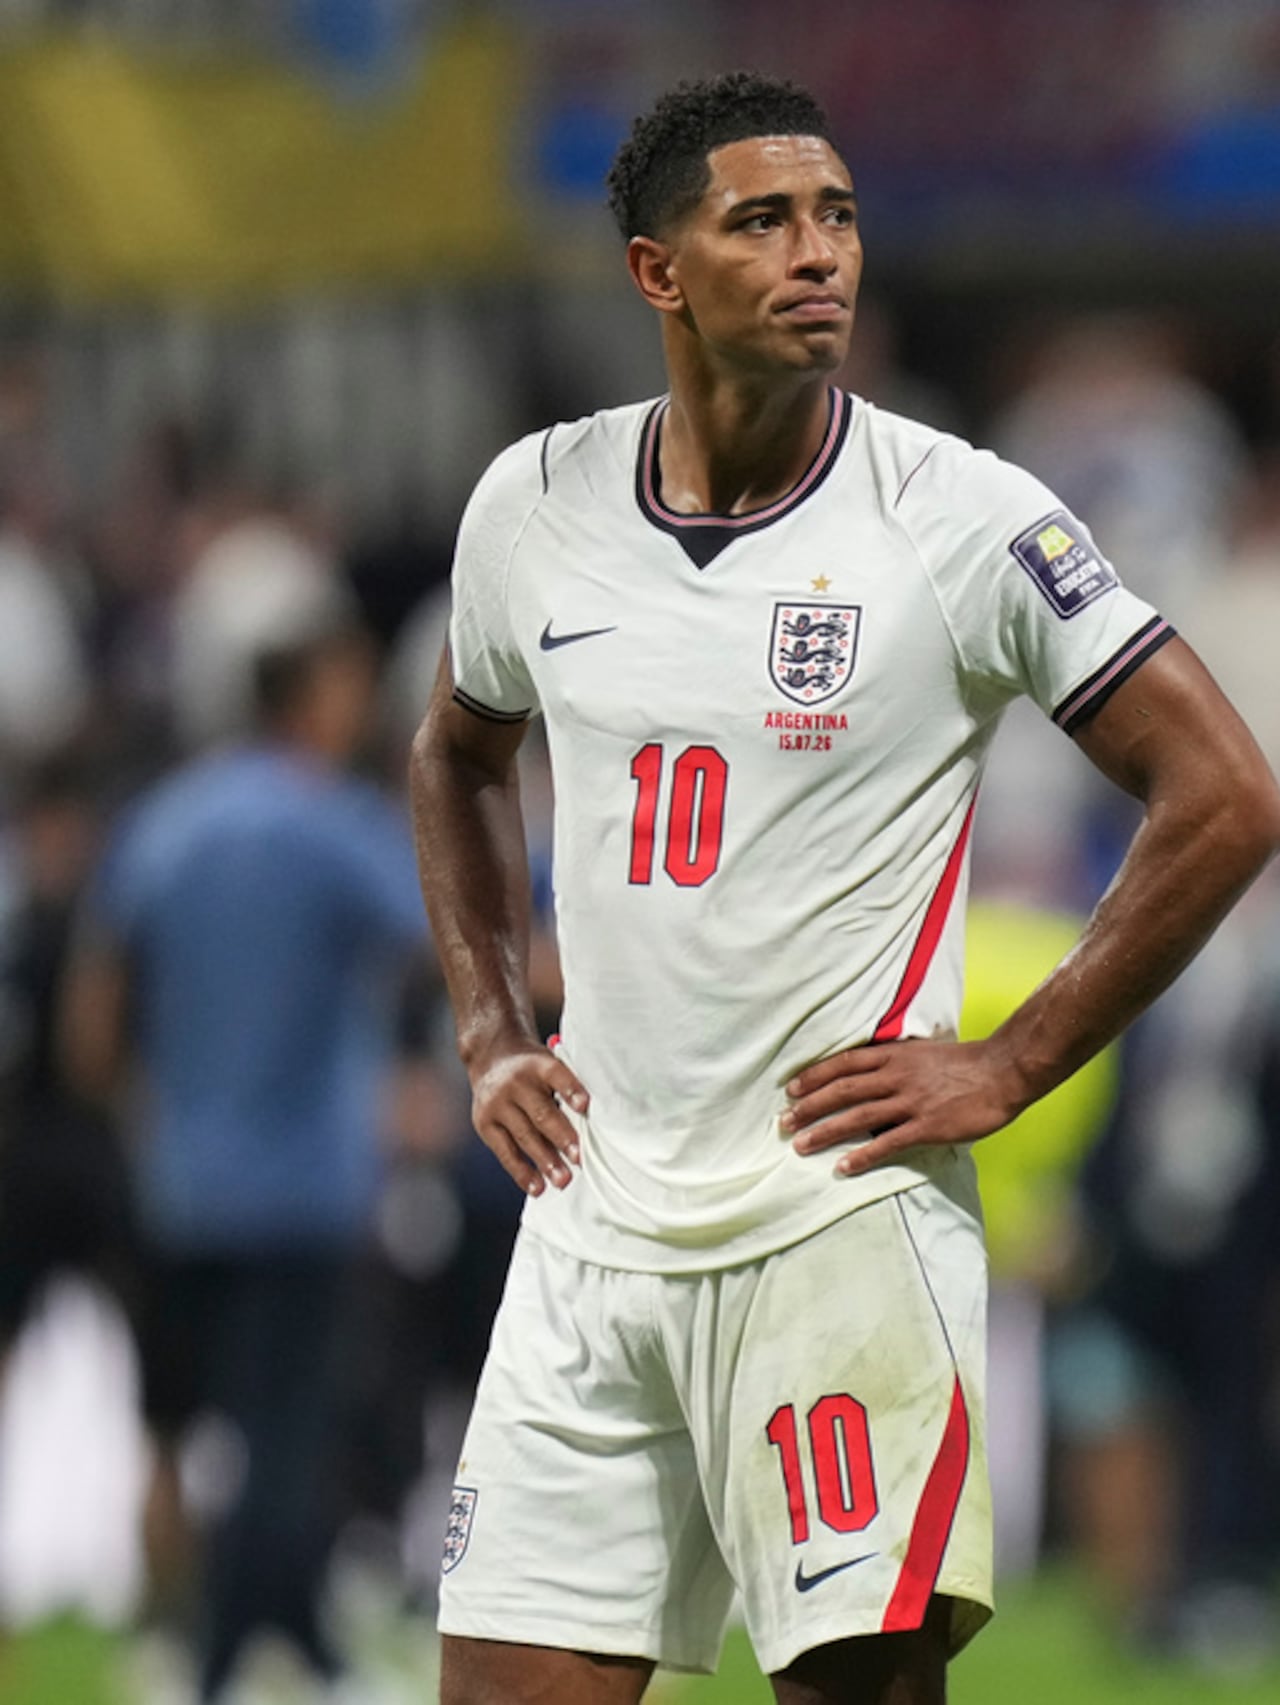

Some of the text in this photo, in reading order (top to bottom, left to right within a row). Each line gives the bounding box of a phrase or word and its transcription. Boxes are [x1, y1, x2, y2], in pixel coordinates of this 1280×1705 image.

[764, 712, 848, 730] ARGENTINA
[779, 733, 832, 751] 15.07.26
[629, 744, 729, 888] 10
[766, 1393, 880, 1545] 10
